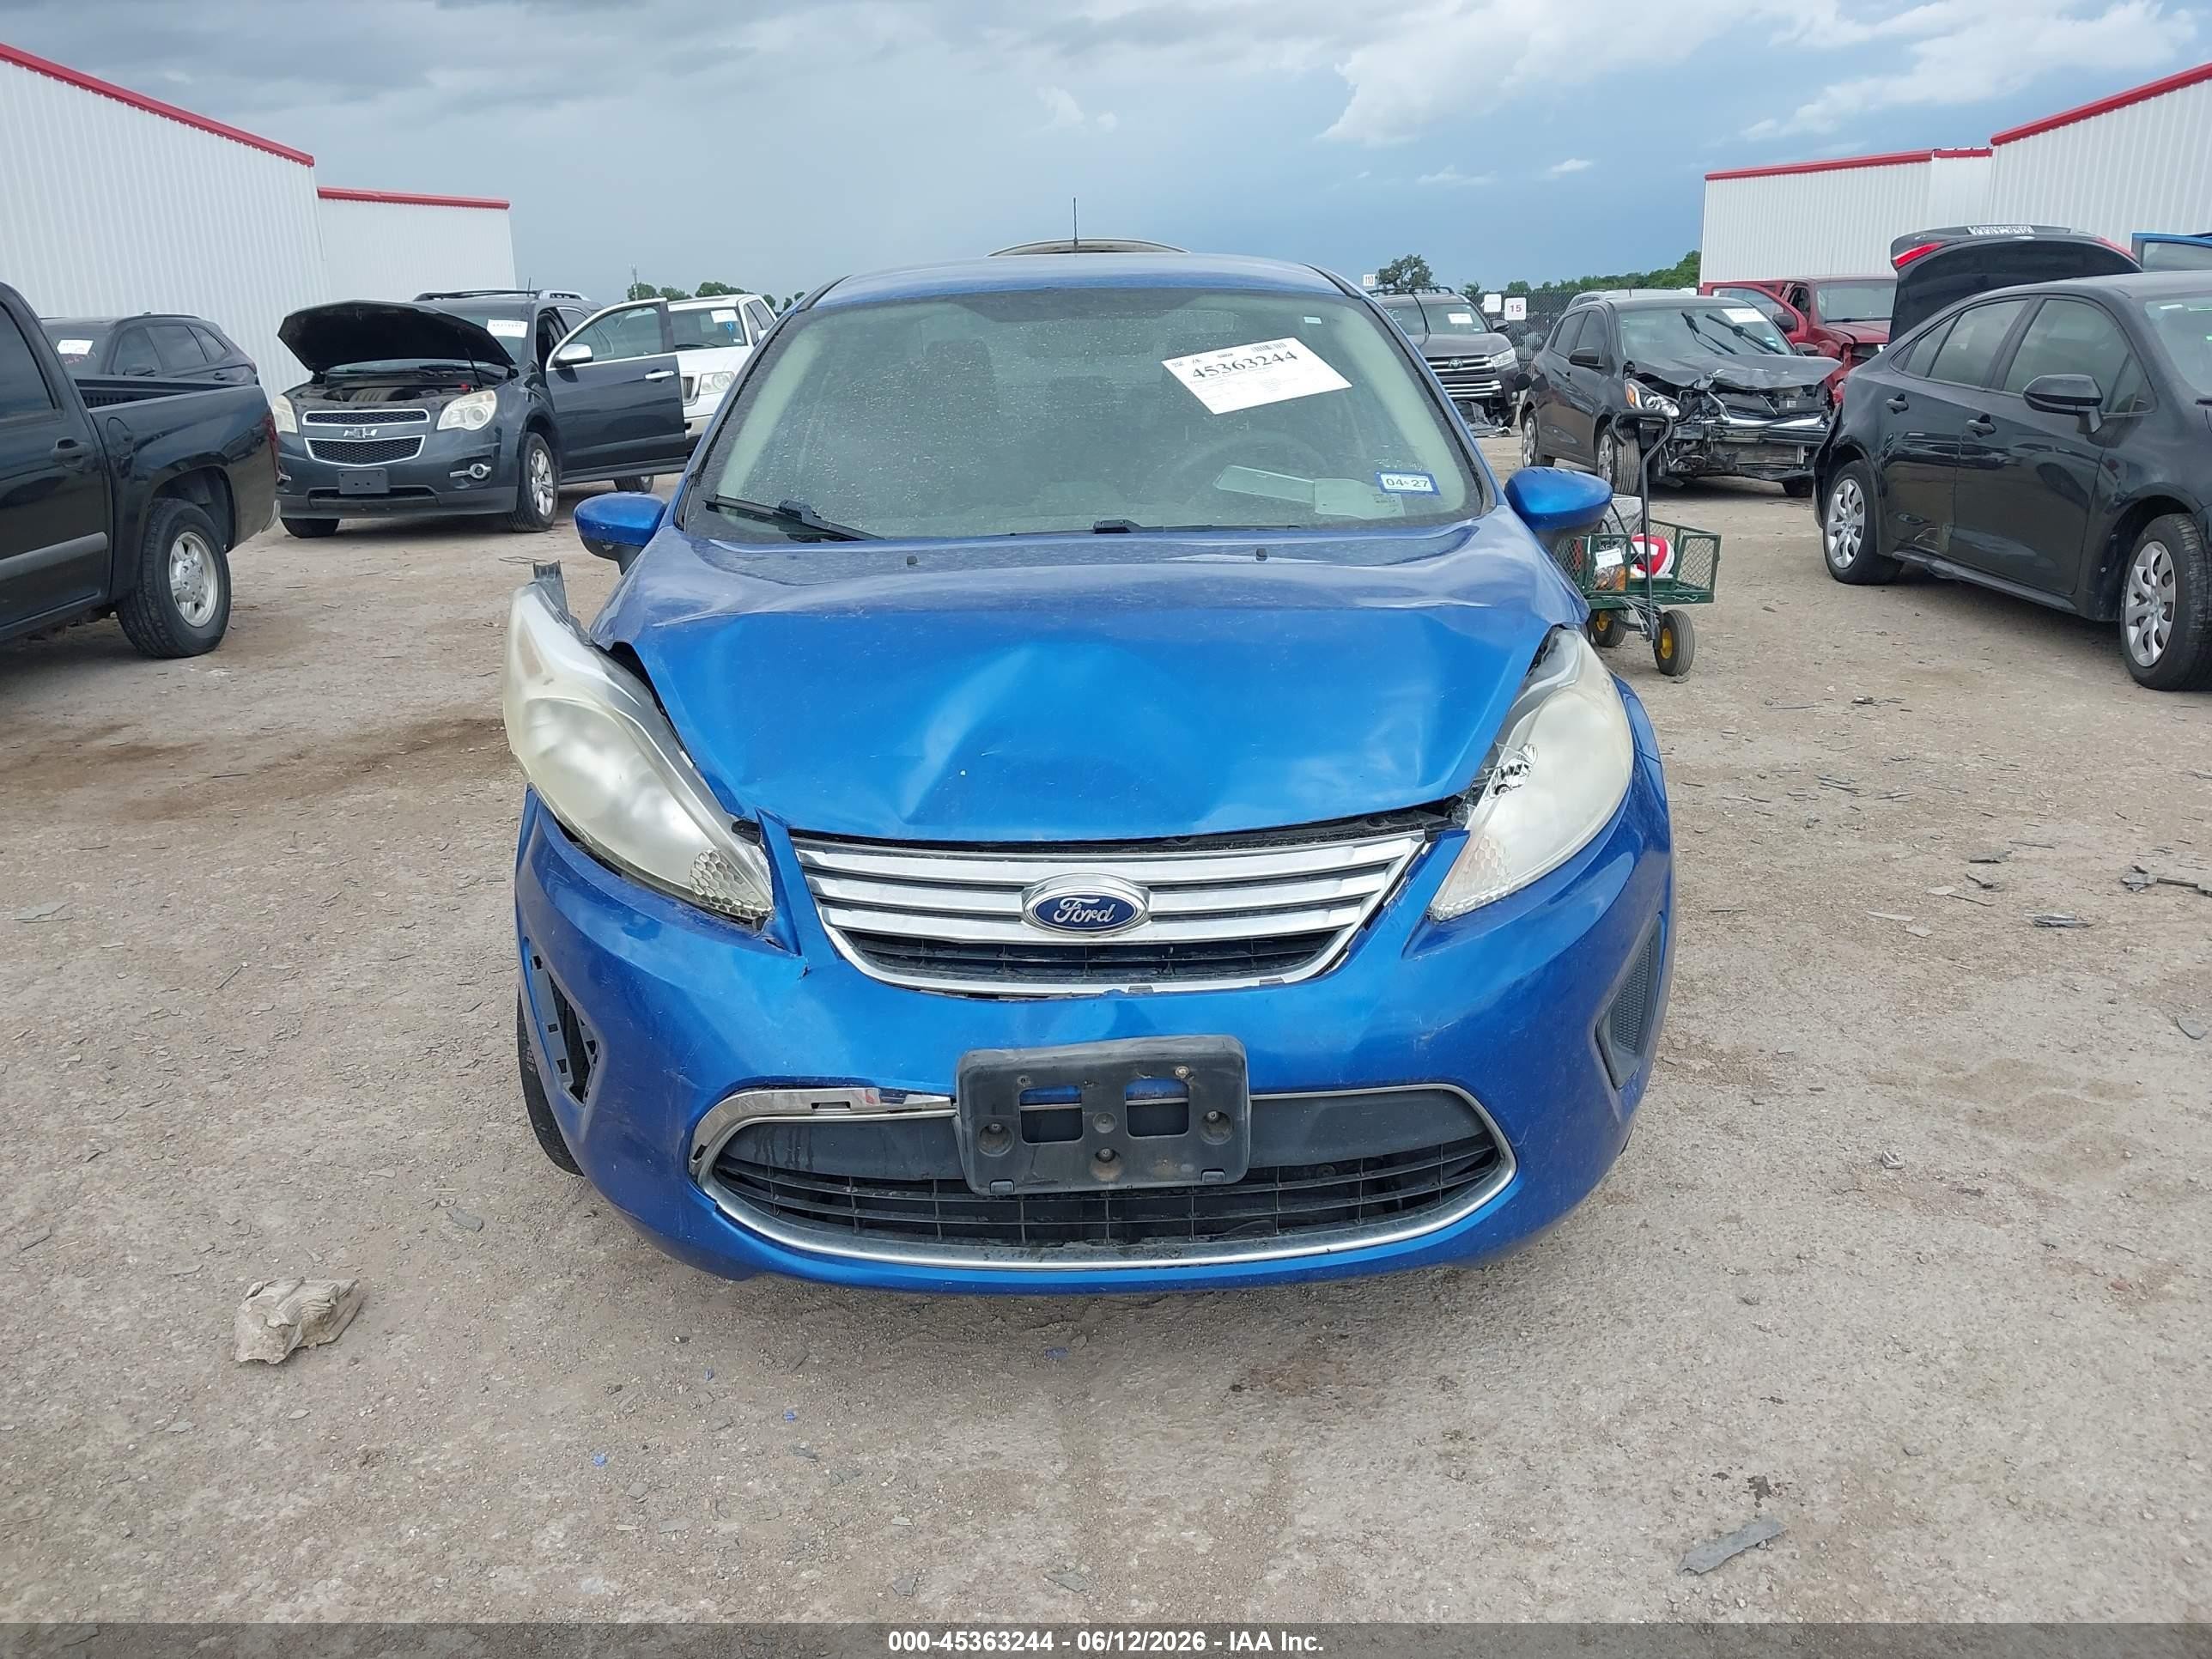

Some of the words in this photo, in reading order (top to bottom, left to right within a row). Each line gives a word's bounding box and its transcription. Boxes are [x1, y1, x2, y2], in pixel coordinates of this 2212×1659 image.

[1510, 304, 1522, 313] 15
[1192, 349, 1298, 380] 45363244
[1386, 478, 1404, 487] 04
[1411, 479, 1429, 488] 27
[1053, 896, 1116, 923] Ford
